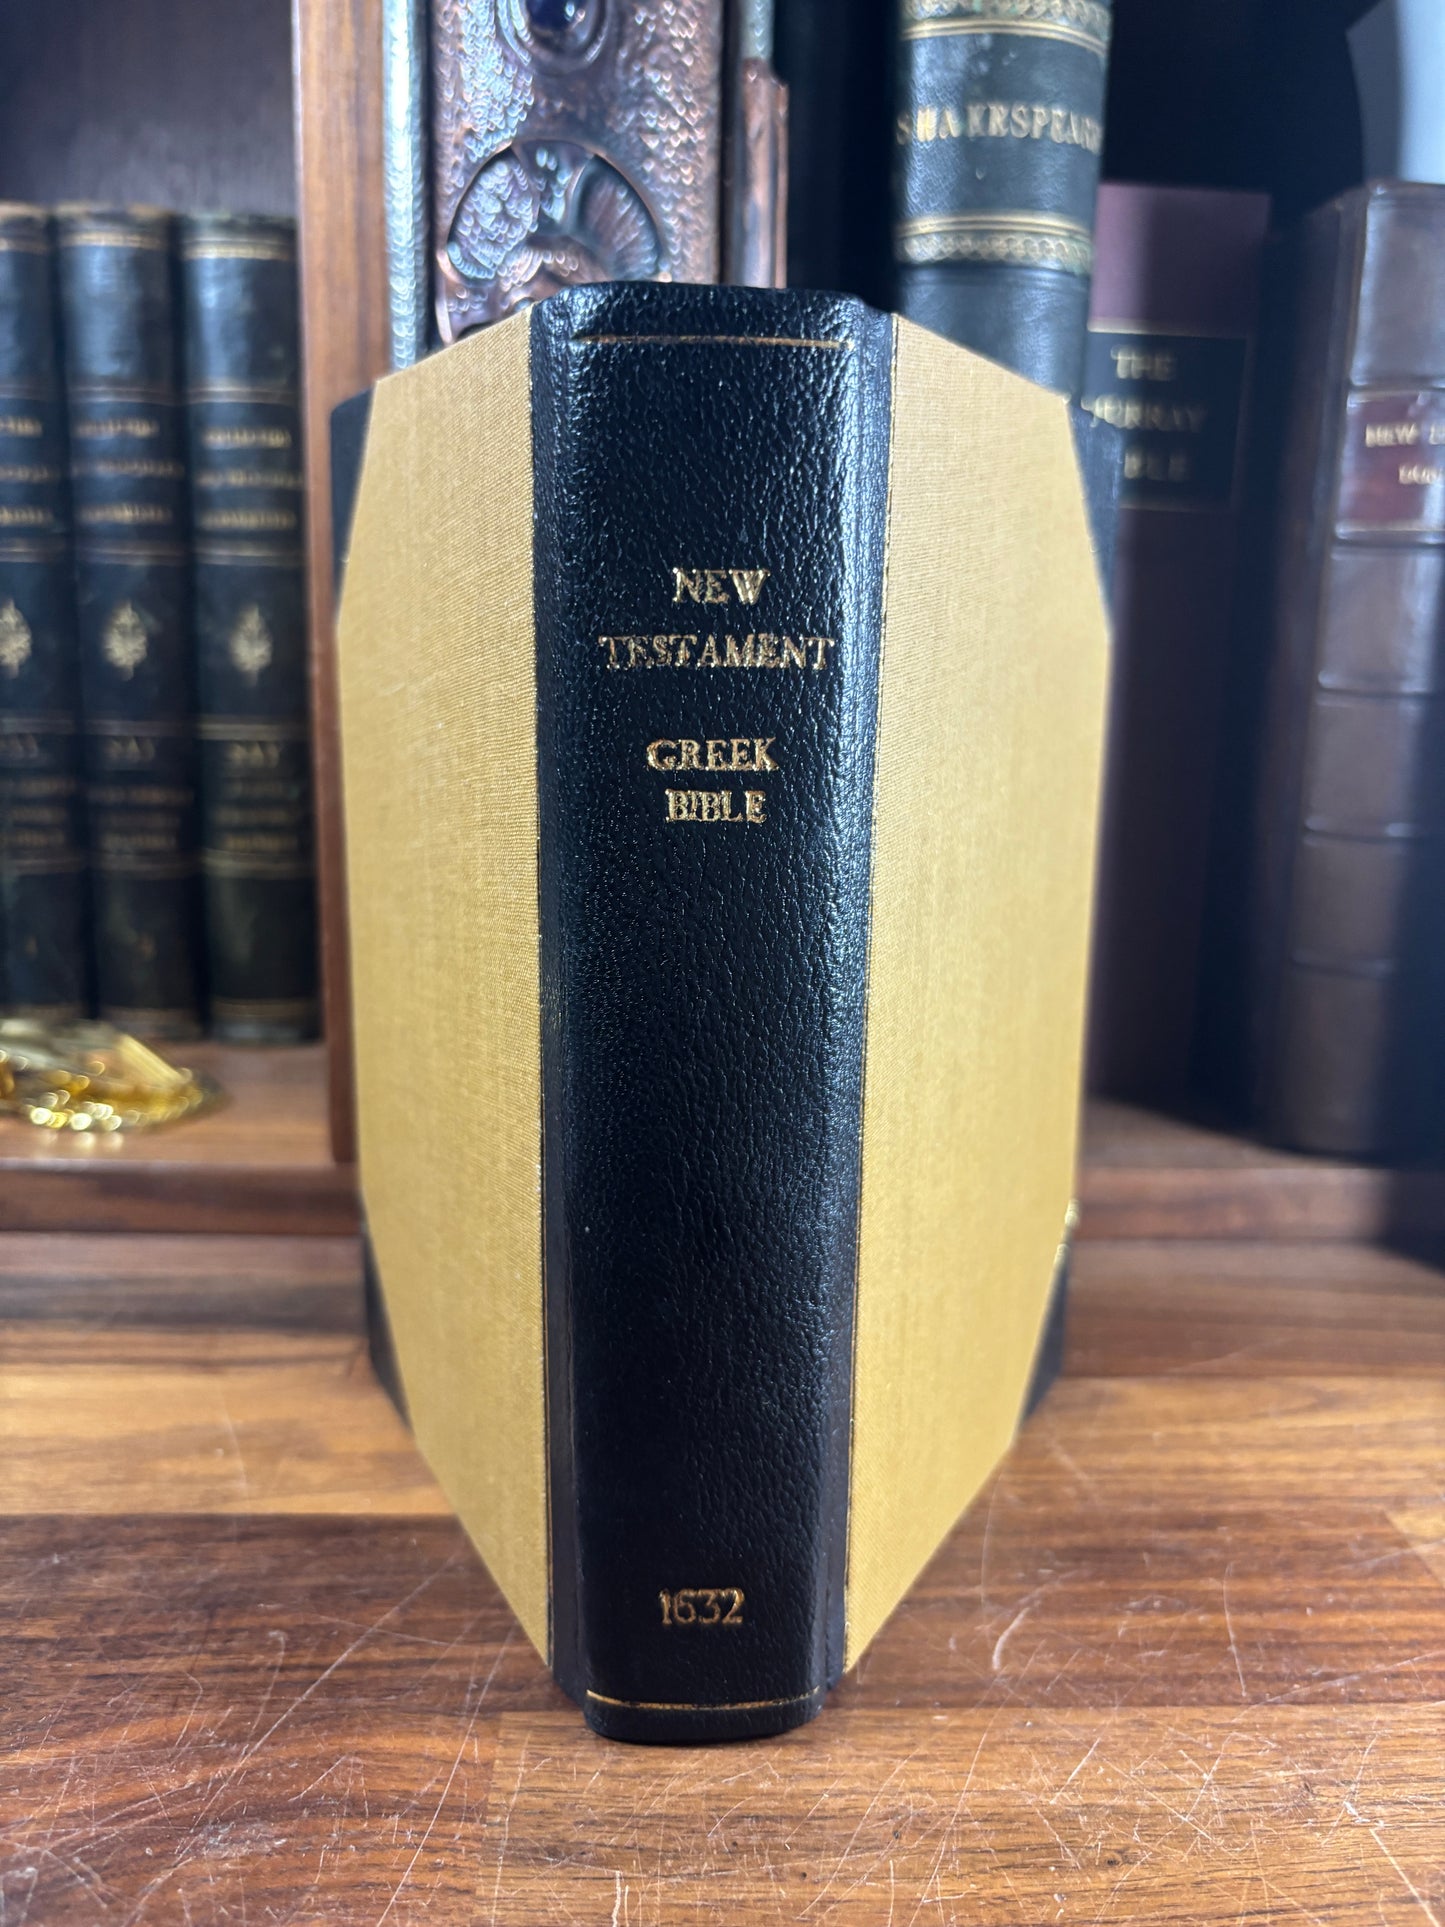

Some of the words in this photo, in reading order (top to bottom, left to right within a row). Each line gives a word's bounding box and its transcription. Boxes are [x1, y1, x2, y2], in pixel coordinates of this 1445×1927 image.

[672, 567, 770, 604] NEW
[598, 634, 835, 670] TESTAMENT
[646, 738, 780, 771] GREEK
[665, 788, 767, 824] BIBLE
[659, 1587, 745, 1625] 1632
